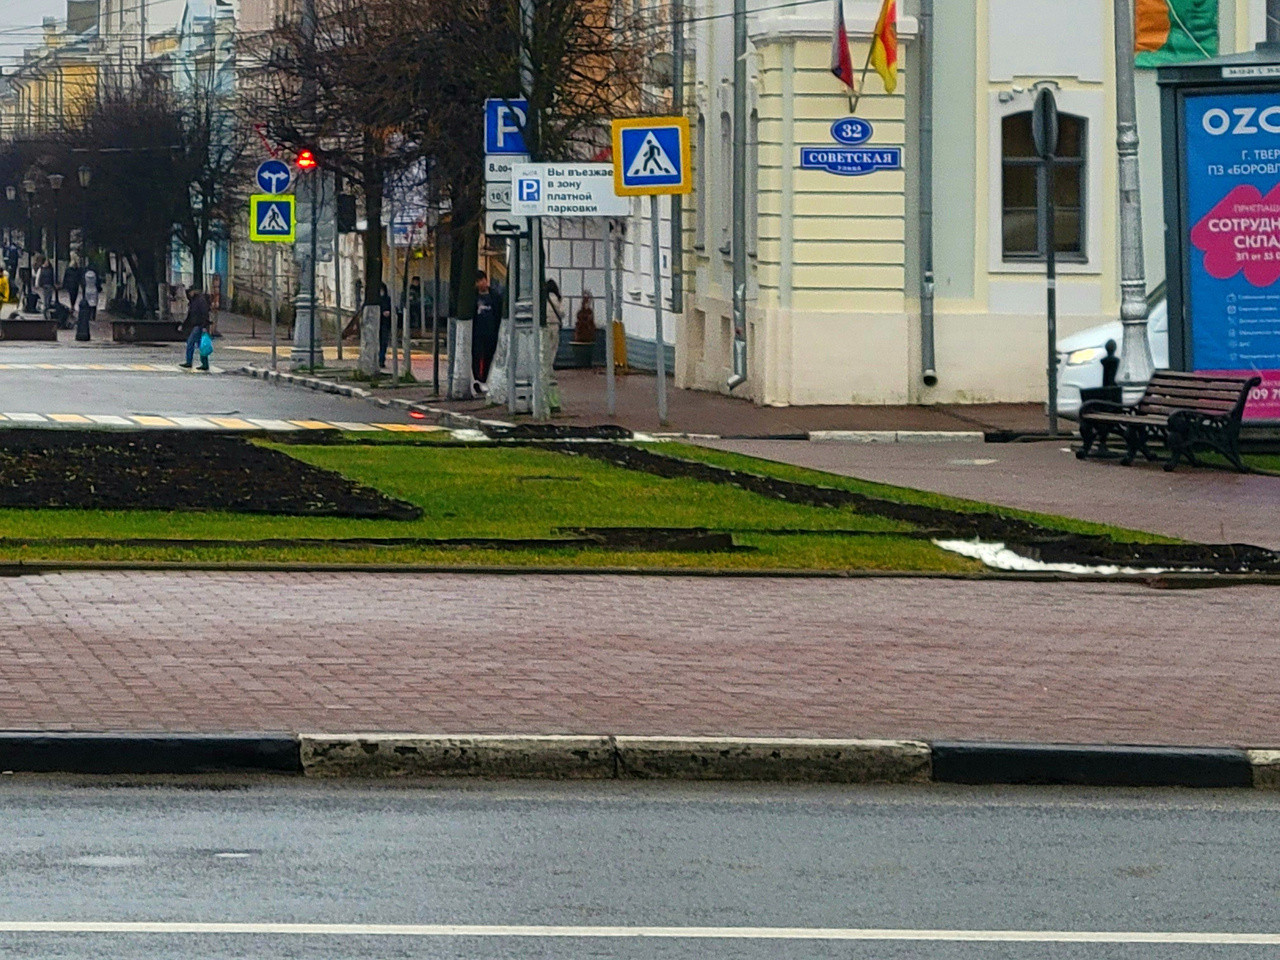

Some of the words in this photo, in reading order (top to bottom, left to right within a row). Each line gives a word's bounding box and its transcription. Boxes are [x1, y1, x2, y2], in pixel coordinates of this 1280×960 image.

[497, 106, 527, 147] P
[841, 124, 862, 138] 32
[809, 152, 892, 163] СОВЕТСКАЯ
[547, 168, 564, 177] Вы
[1208, 165, 1224, 175] ПЗ
[557, 181, 581, 190] зону
[491, 192, 500, 200] 10
[547, 192, 592, 201] платной
[547, 205, 597, 213] парковки
